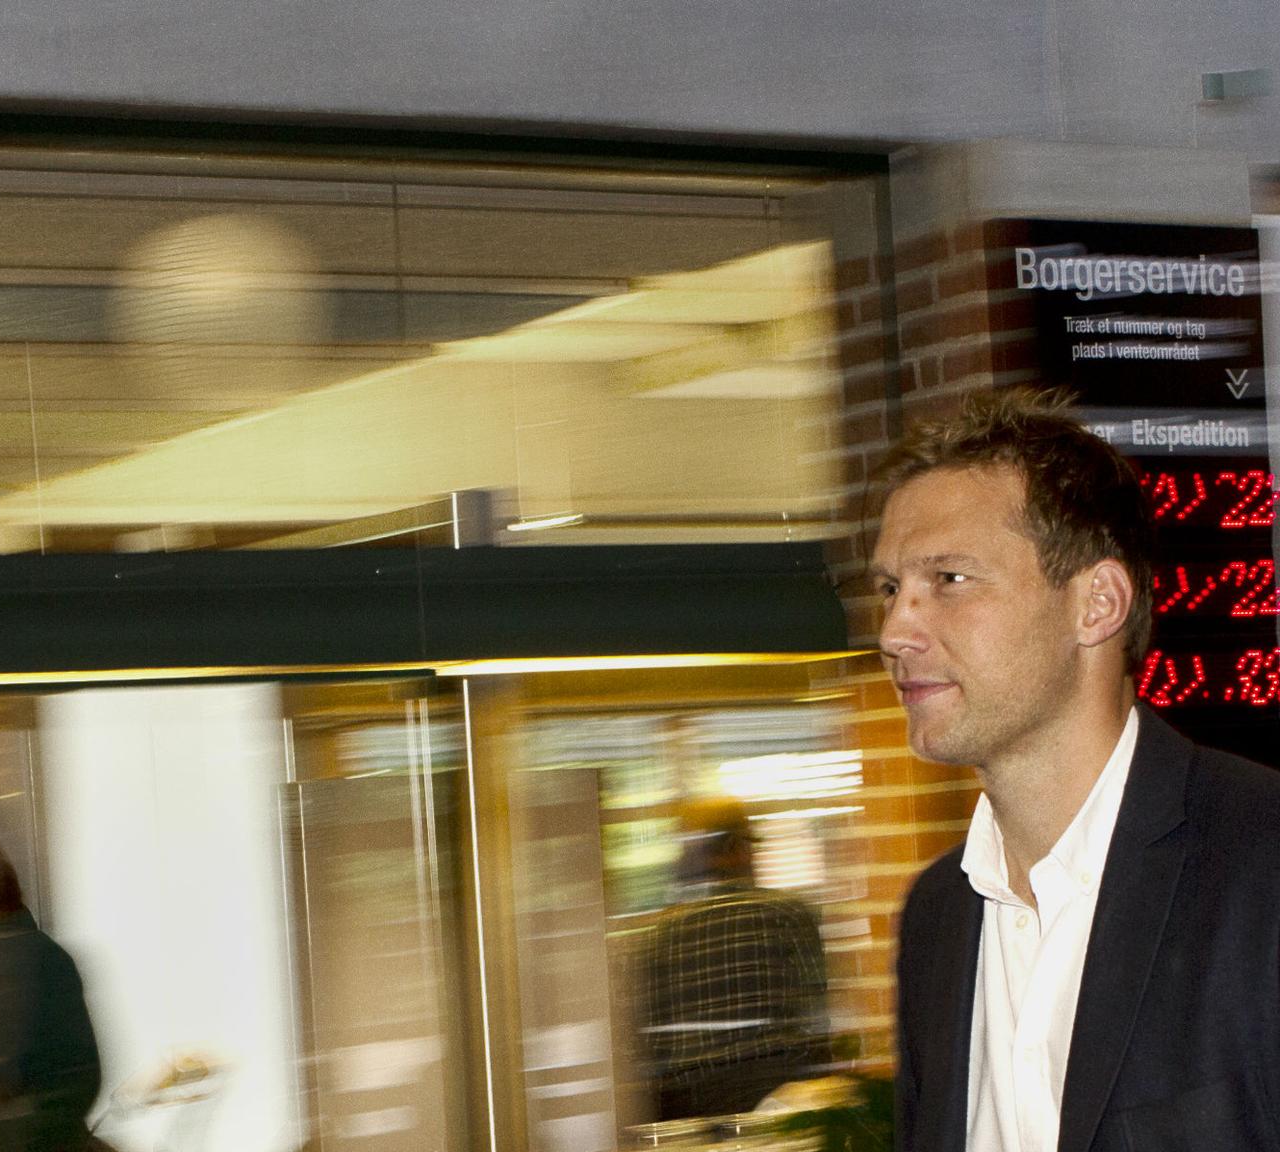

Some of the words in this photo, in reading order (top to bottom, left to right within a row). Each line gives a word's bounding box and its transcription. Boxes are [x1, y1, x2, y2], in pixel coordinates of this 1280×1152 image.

[1015, 247, 1246, 301] Borgerservice
[1063, 316, 1095, 334] Træk
[1098, 318, 1111, 335] et
[1114, 320, 1164, 336] nummer
[1167, 323, 1182, 339] og
[1185, 320, 1206, 340] tag
[1071, 342, 1106, 362] plads
[1119, 342, 1200, 361] venteområdet
[1131, 419, 1250, 452] Ekspedition
